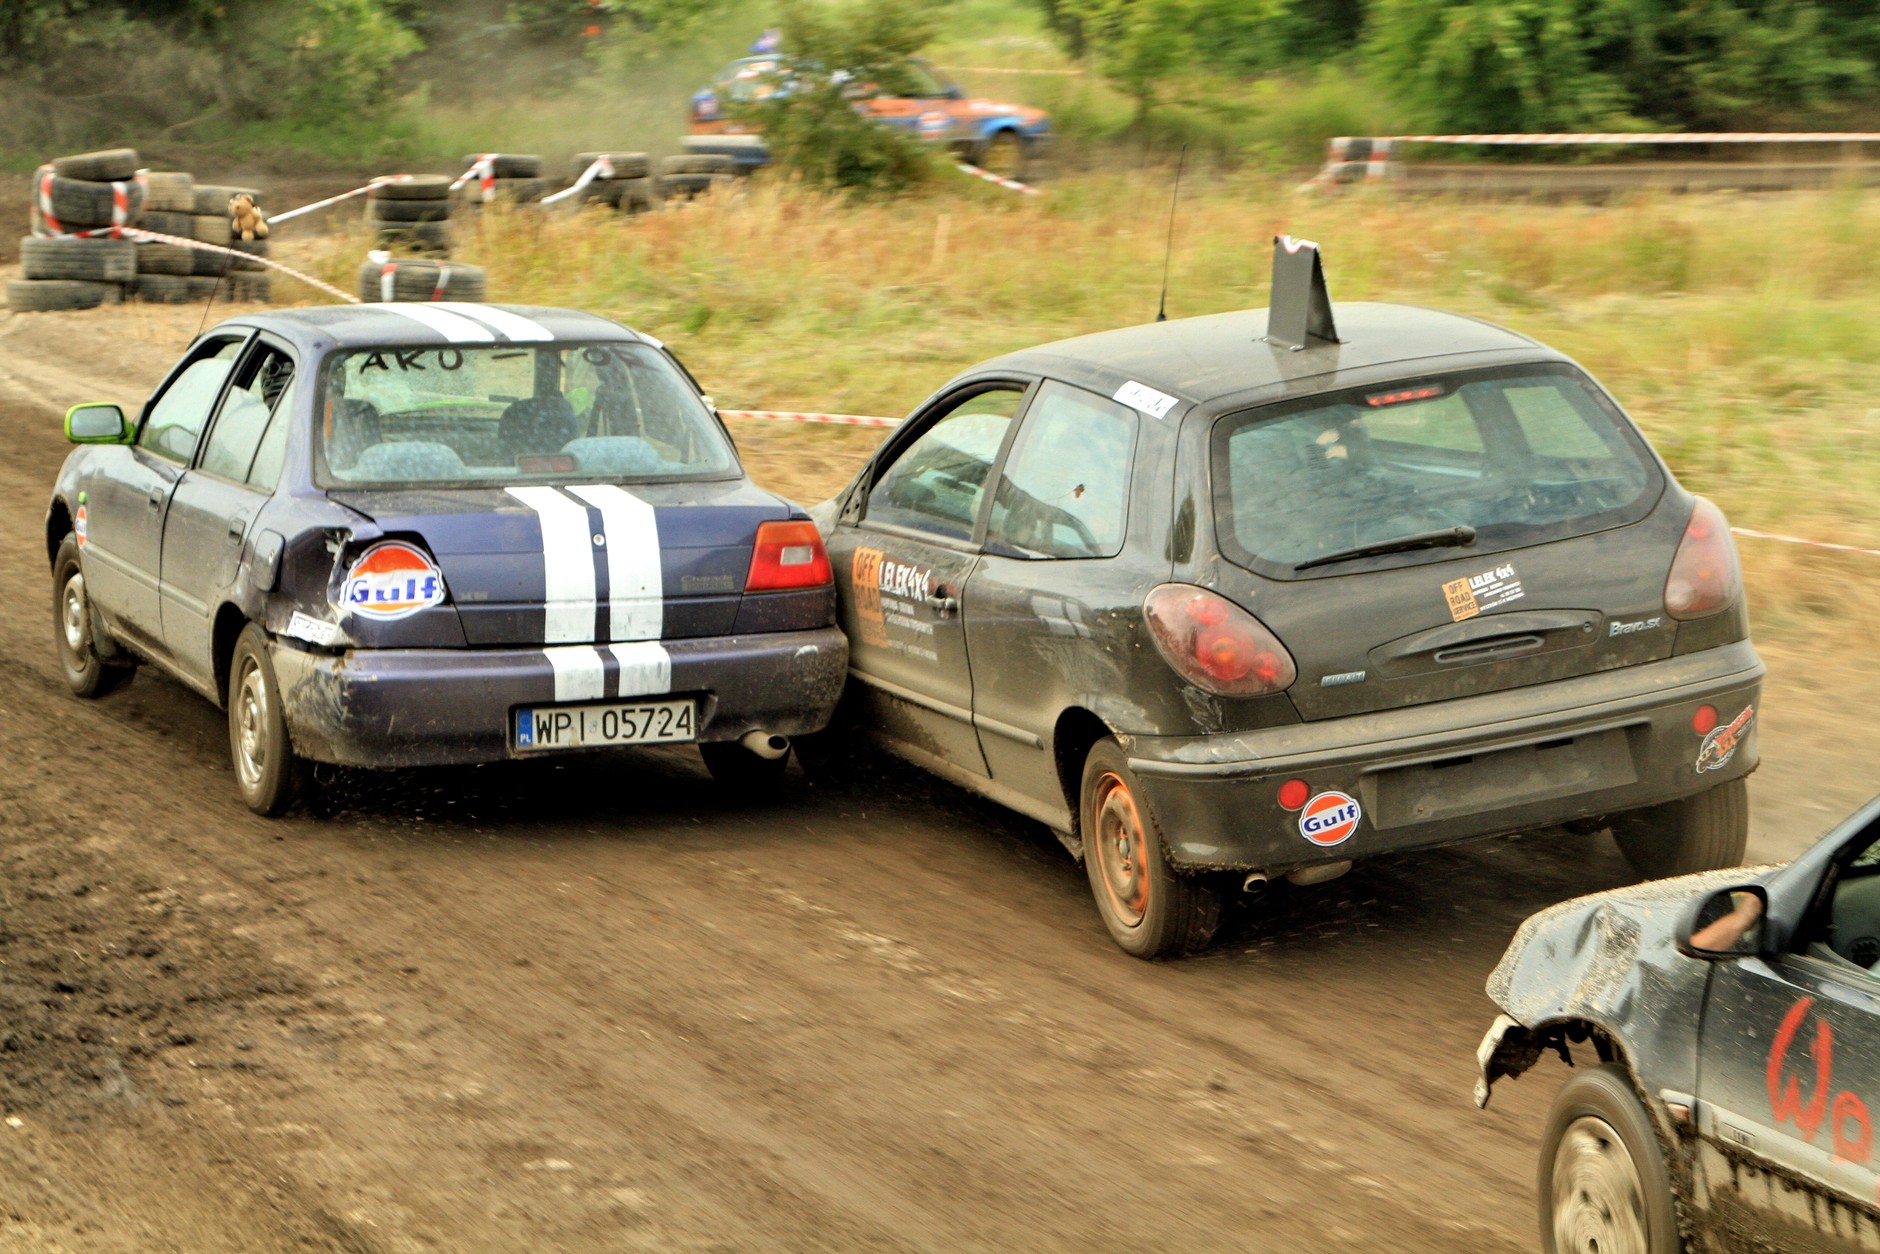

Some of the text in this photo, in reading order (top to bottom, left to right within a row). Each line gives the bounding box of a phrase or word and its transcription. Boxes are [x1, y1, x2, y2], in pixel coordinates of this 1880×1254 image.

[350, 576, 437, 603] Gulf
[1448, 581, 1464, 595] OFF
[1450, 591, 1471, 607] ROAD
[535, 705, 691, 744] WPI 05724
[520, 733, 532, 744] PL
[1303, 804, 1356, 832] Gulf
